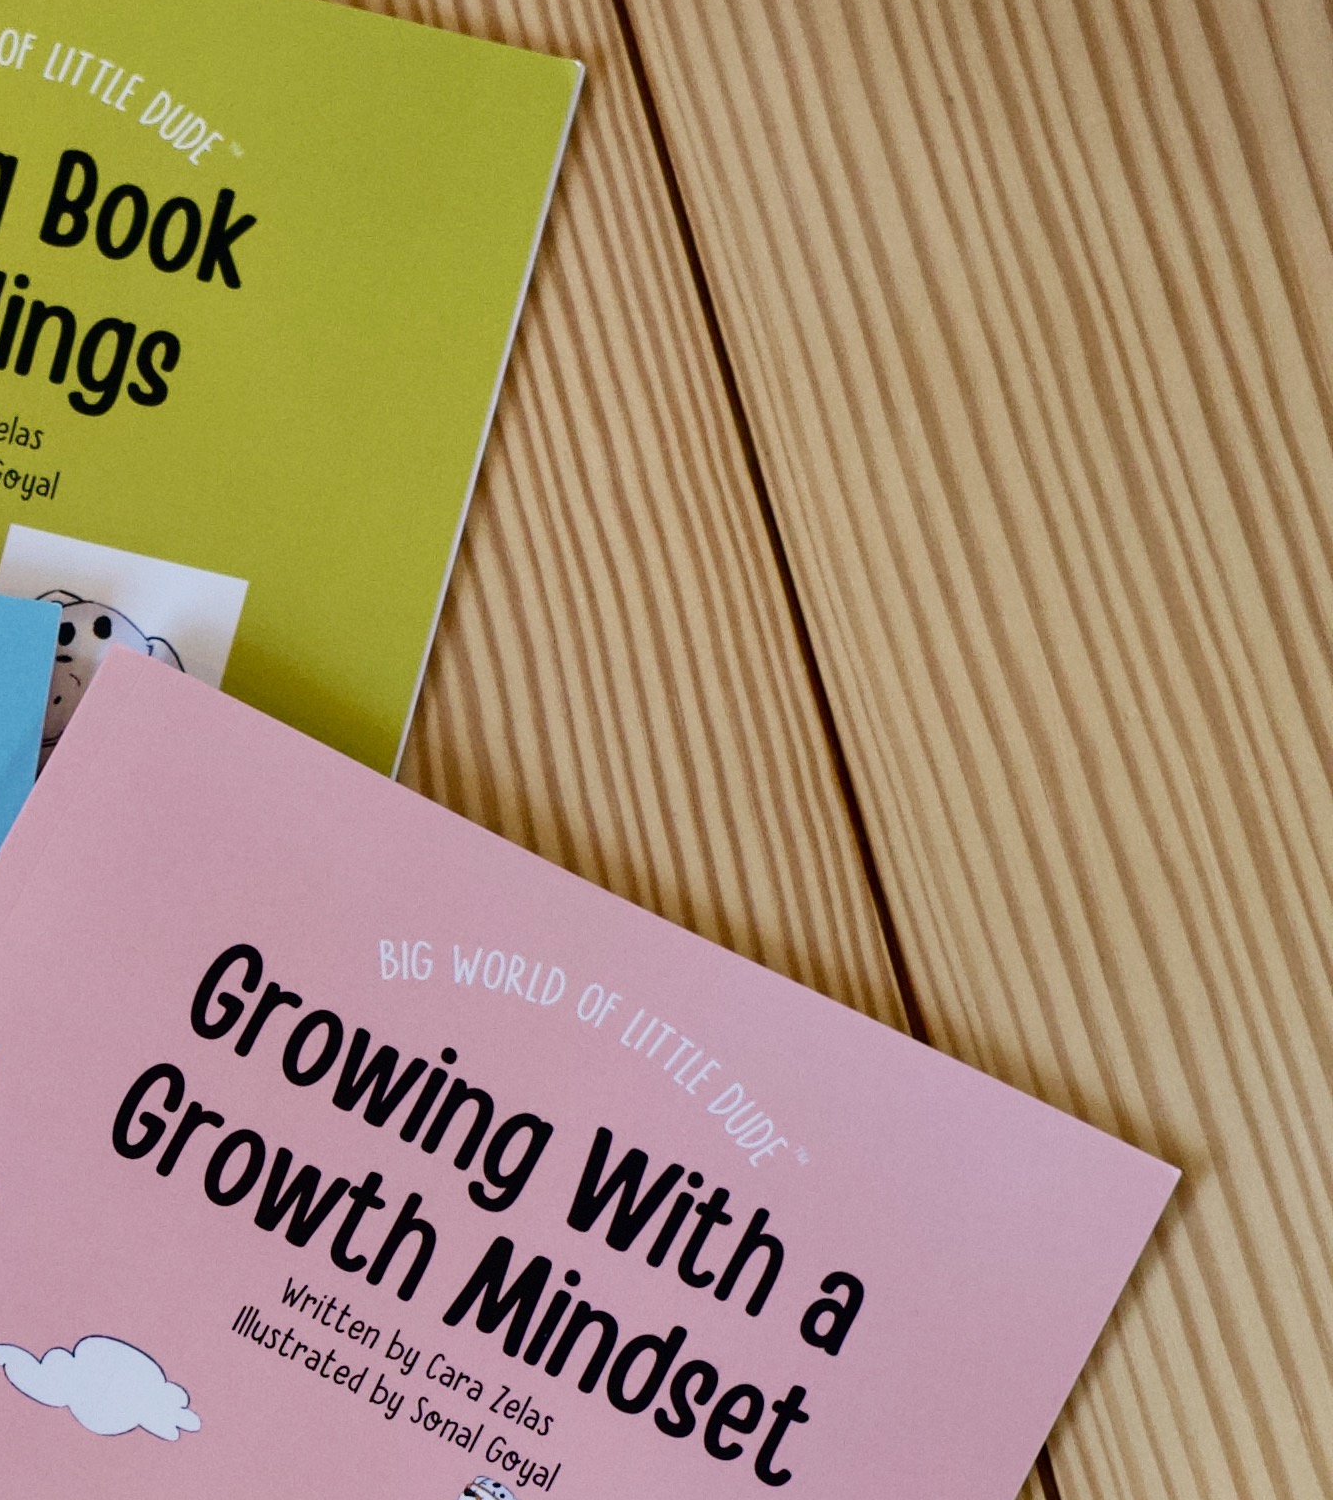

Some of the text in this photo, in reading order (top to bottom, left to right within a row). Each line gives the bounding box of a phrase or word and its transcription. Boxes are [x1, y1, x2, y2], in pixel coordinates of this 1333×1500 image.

[43, 43, 144, 111] LITTLE
[40, 149, 257, 289] Book
[380, 940, 432, 980] BIG
[454, 945, 565, 1005] WORLD
[577, 984, 621, 1027] OF
[621, 1010, 720, 1094] LITTLE
[191, 944, 864, 1356] Growing With a
[112, 1062, 809, 1491] Growth Mindset
[232, 1305, 561, 1491] Illustrated by Sonal Goyal
[279, 1278, 554, 1436] Written by Cara Zelas
